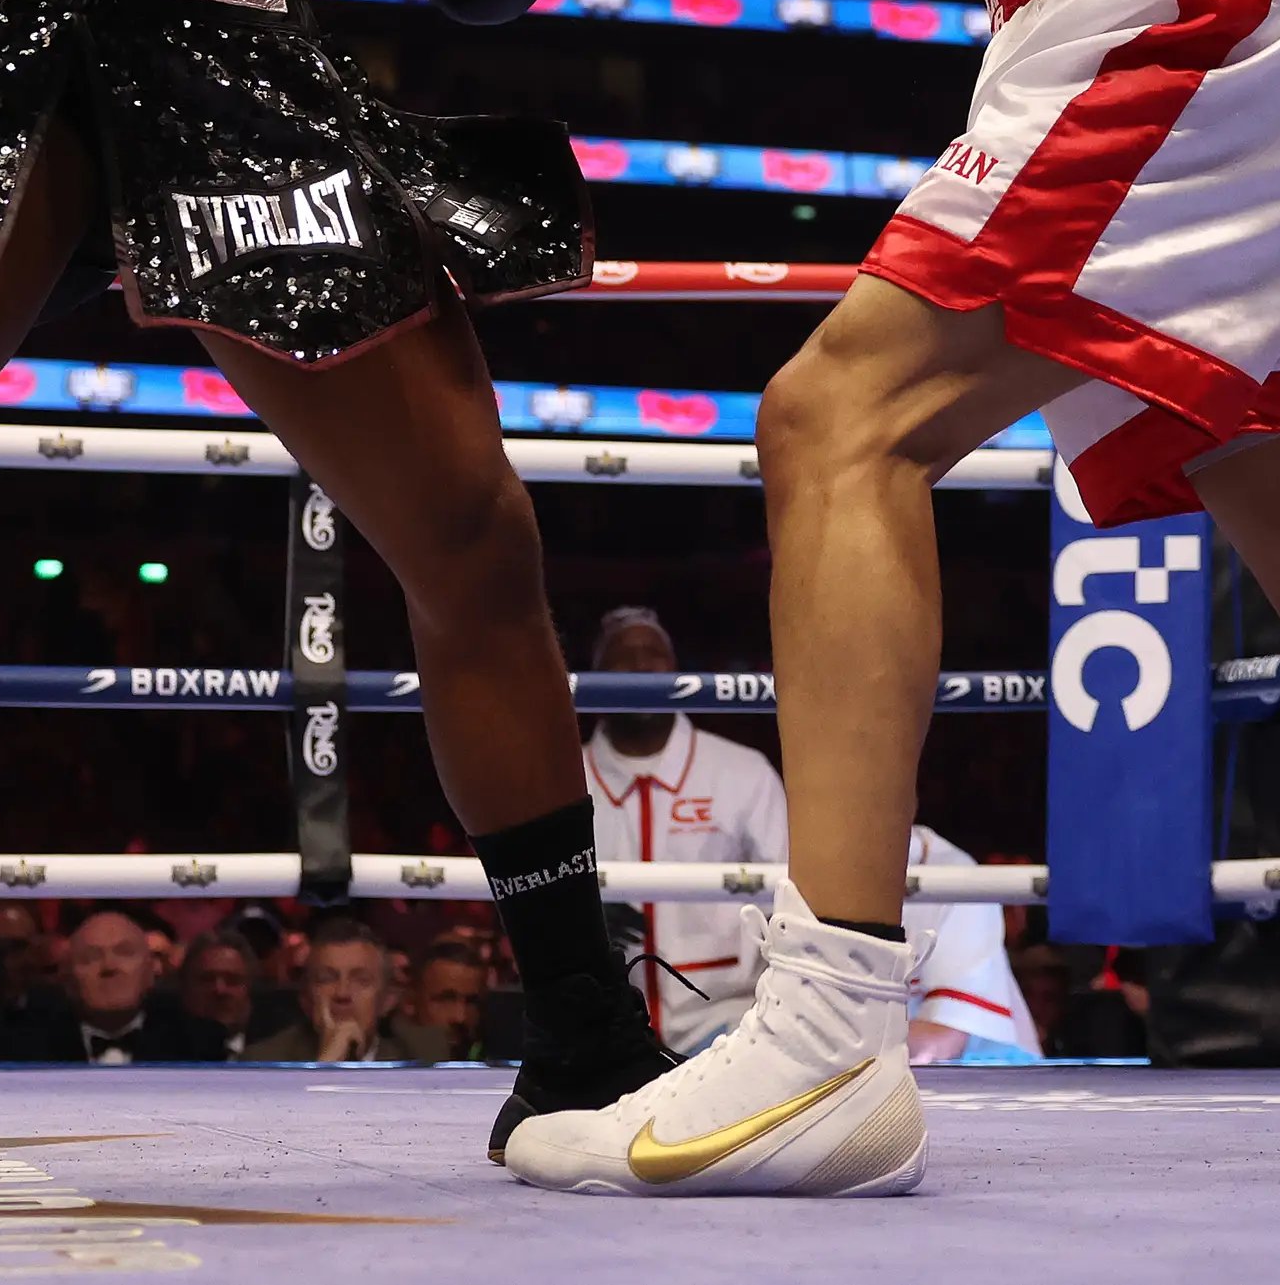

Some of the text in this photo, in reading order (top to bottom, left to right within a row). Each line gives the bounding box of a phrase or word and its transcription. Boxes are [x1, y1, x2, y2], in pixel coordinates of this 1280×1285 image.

[172, 170, 364, 279] EVERLAST
[300, 592, 336, 664] RING
[130, 667, 280, 698] BOXRAW
[302, 701, 338, 776] RING
[491, 847, 596, 900] EVERLAST
